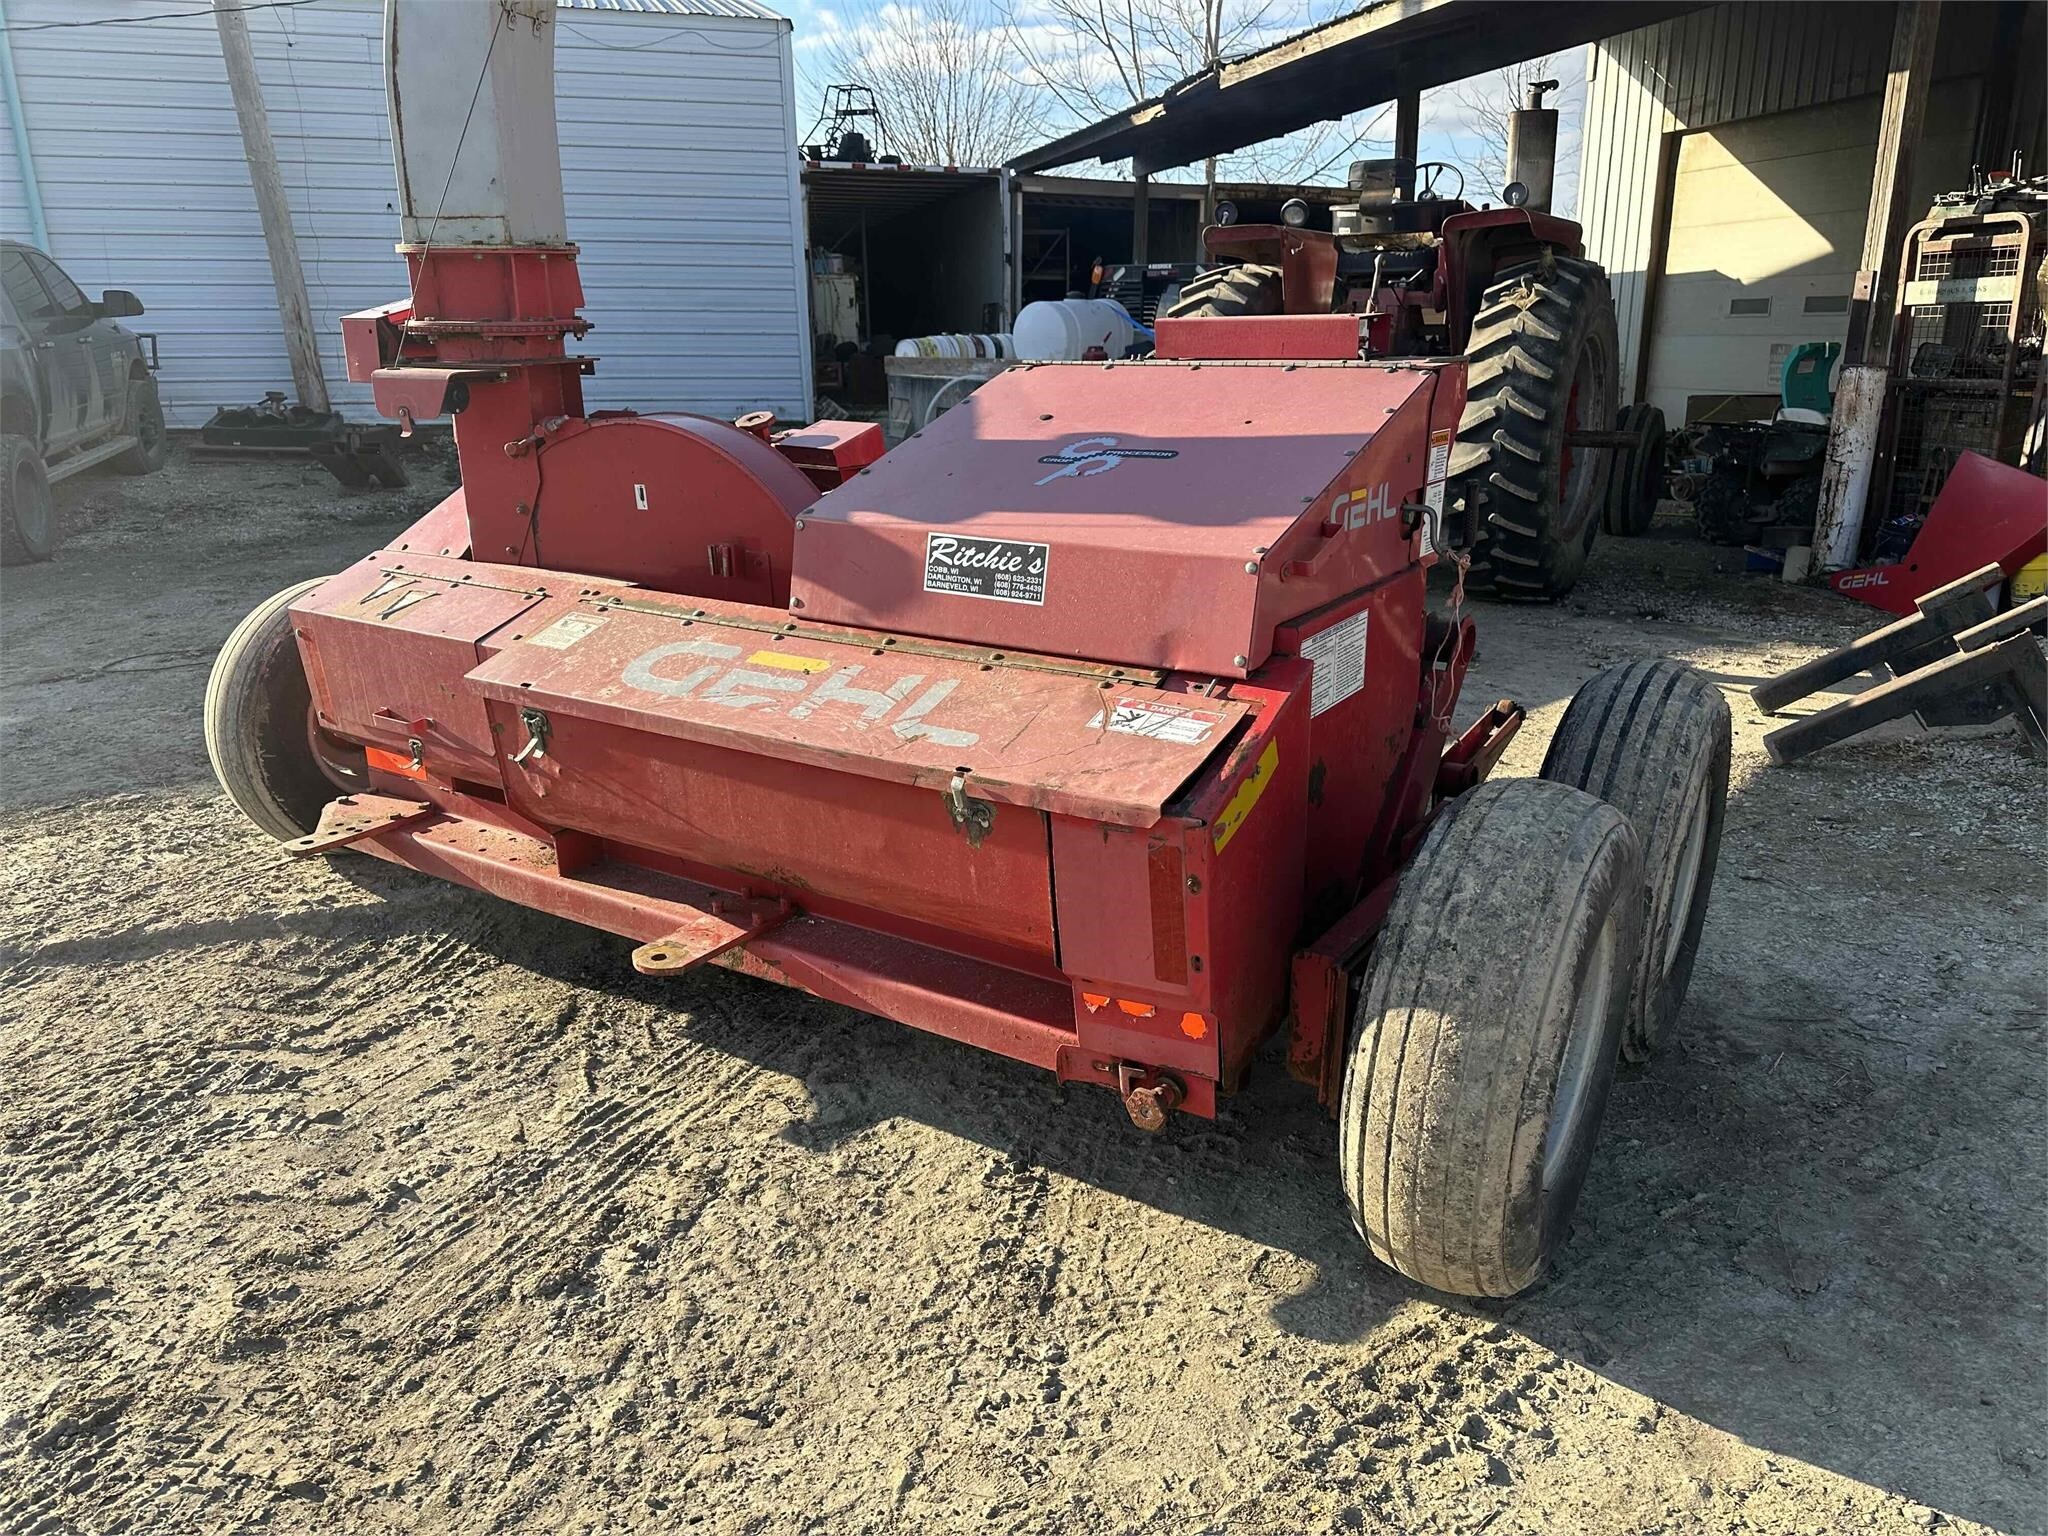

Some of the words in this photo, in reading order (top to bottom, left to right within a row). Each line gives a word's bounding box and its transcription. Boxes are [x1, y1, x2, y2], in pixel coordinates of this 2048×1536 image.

[1329, 481, 1397, 531] GEHL
[929, 538, 1044, 574] Ritchie's
[928, 565, 949, 574] COBB,
[950, 567, 959, 575] WI
[927, 573, 972, 585] DARLINGTON,
[973, 578, 983, 586] WI
[995, 572, 1011, 582] (608)
[1838, 571, 1889, 590] GEHL
[927, 580, 969, 592] BARNEVELD,
[970, 585, 979, 593] WI
[994, 580, 1011, 590] (608)
[993, 588, 1010, 597] (608)
[622, 640, 981, 747] GEHL
[1150, 704, 1195, 718] DANGR
